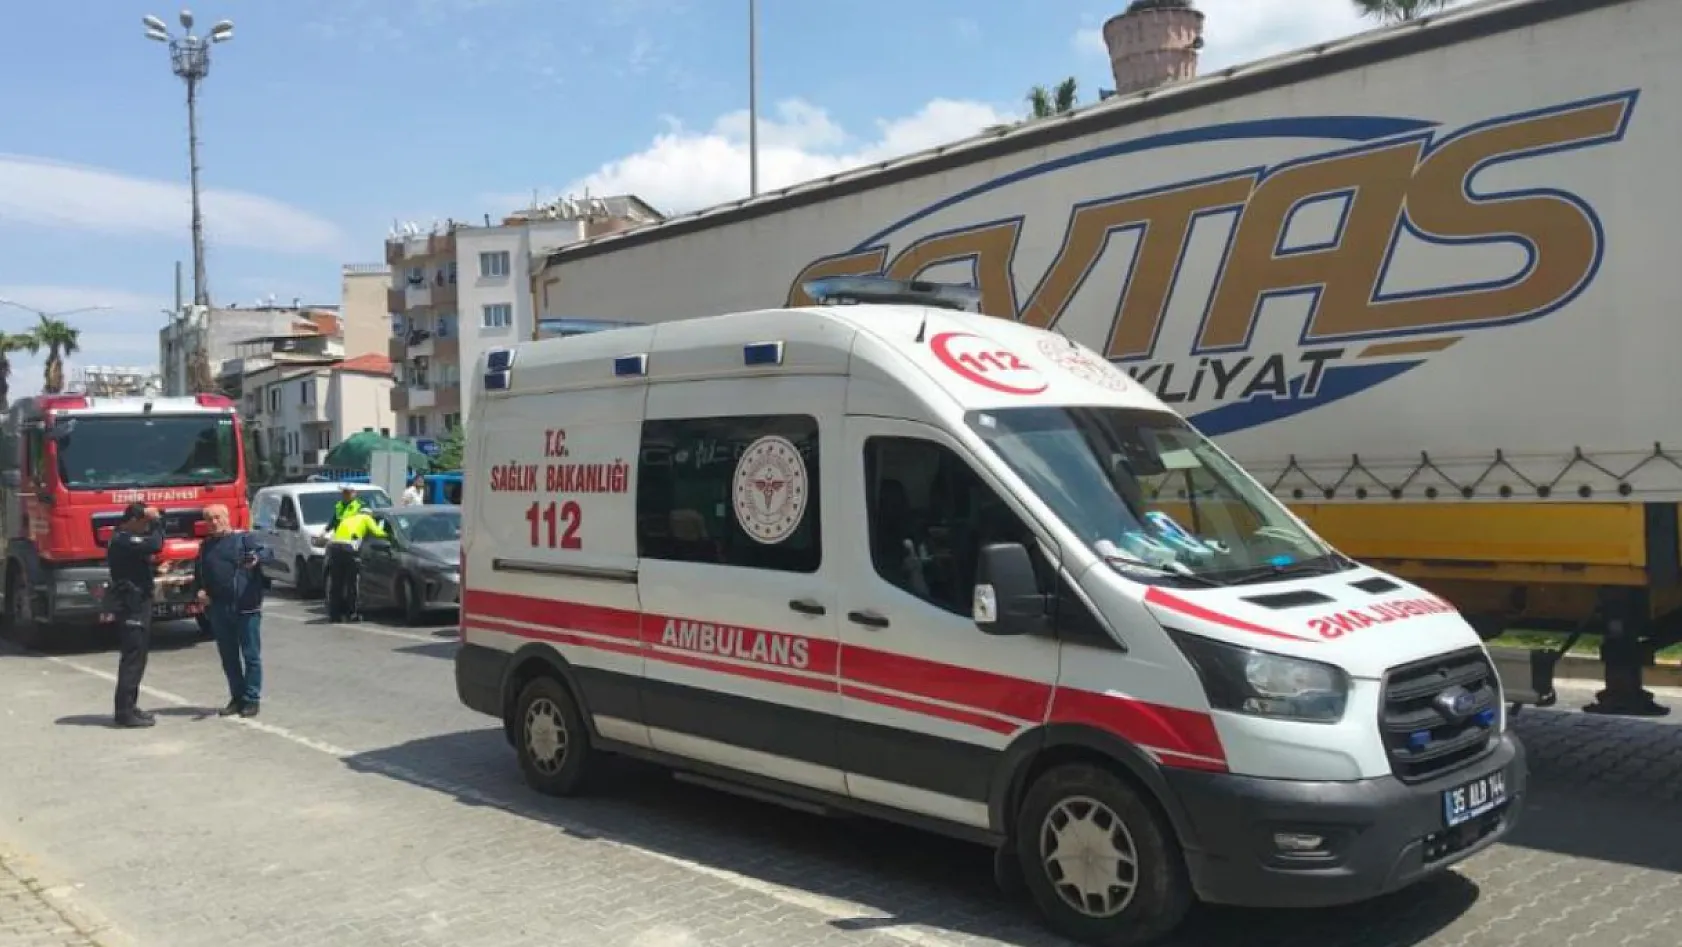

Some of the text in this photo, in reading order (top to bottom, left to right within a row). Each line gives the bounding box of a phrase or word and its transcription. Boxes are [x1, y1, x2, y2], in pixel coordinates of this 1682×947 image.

[959, 351, 1033, 372] 112
[545, 428, 569, 457] T.C.
[491, 457, 629, 493] SAĞLIK BAKANLIĞI
[525, 501, 582, 549] 112
[662, 619, 809, 669] AMBULANS
[1453, 787, 1465, 813] 35
